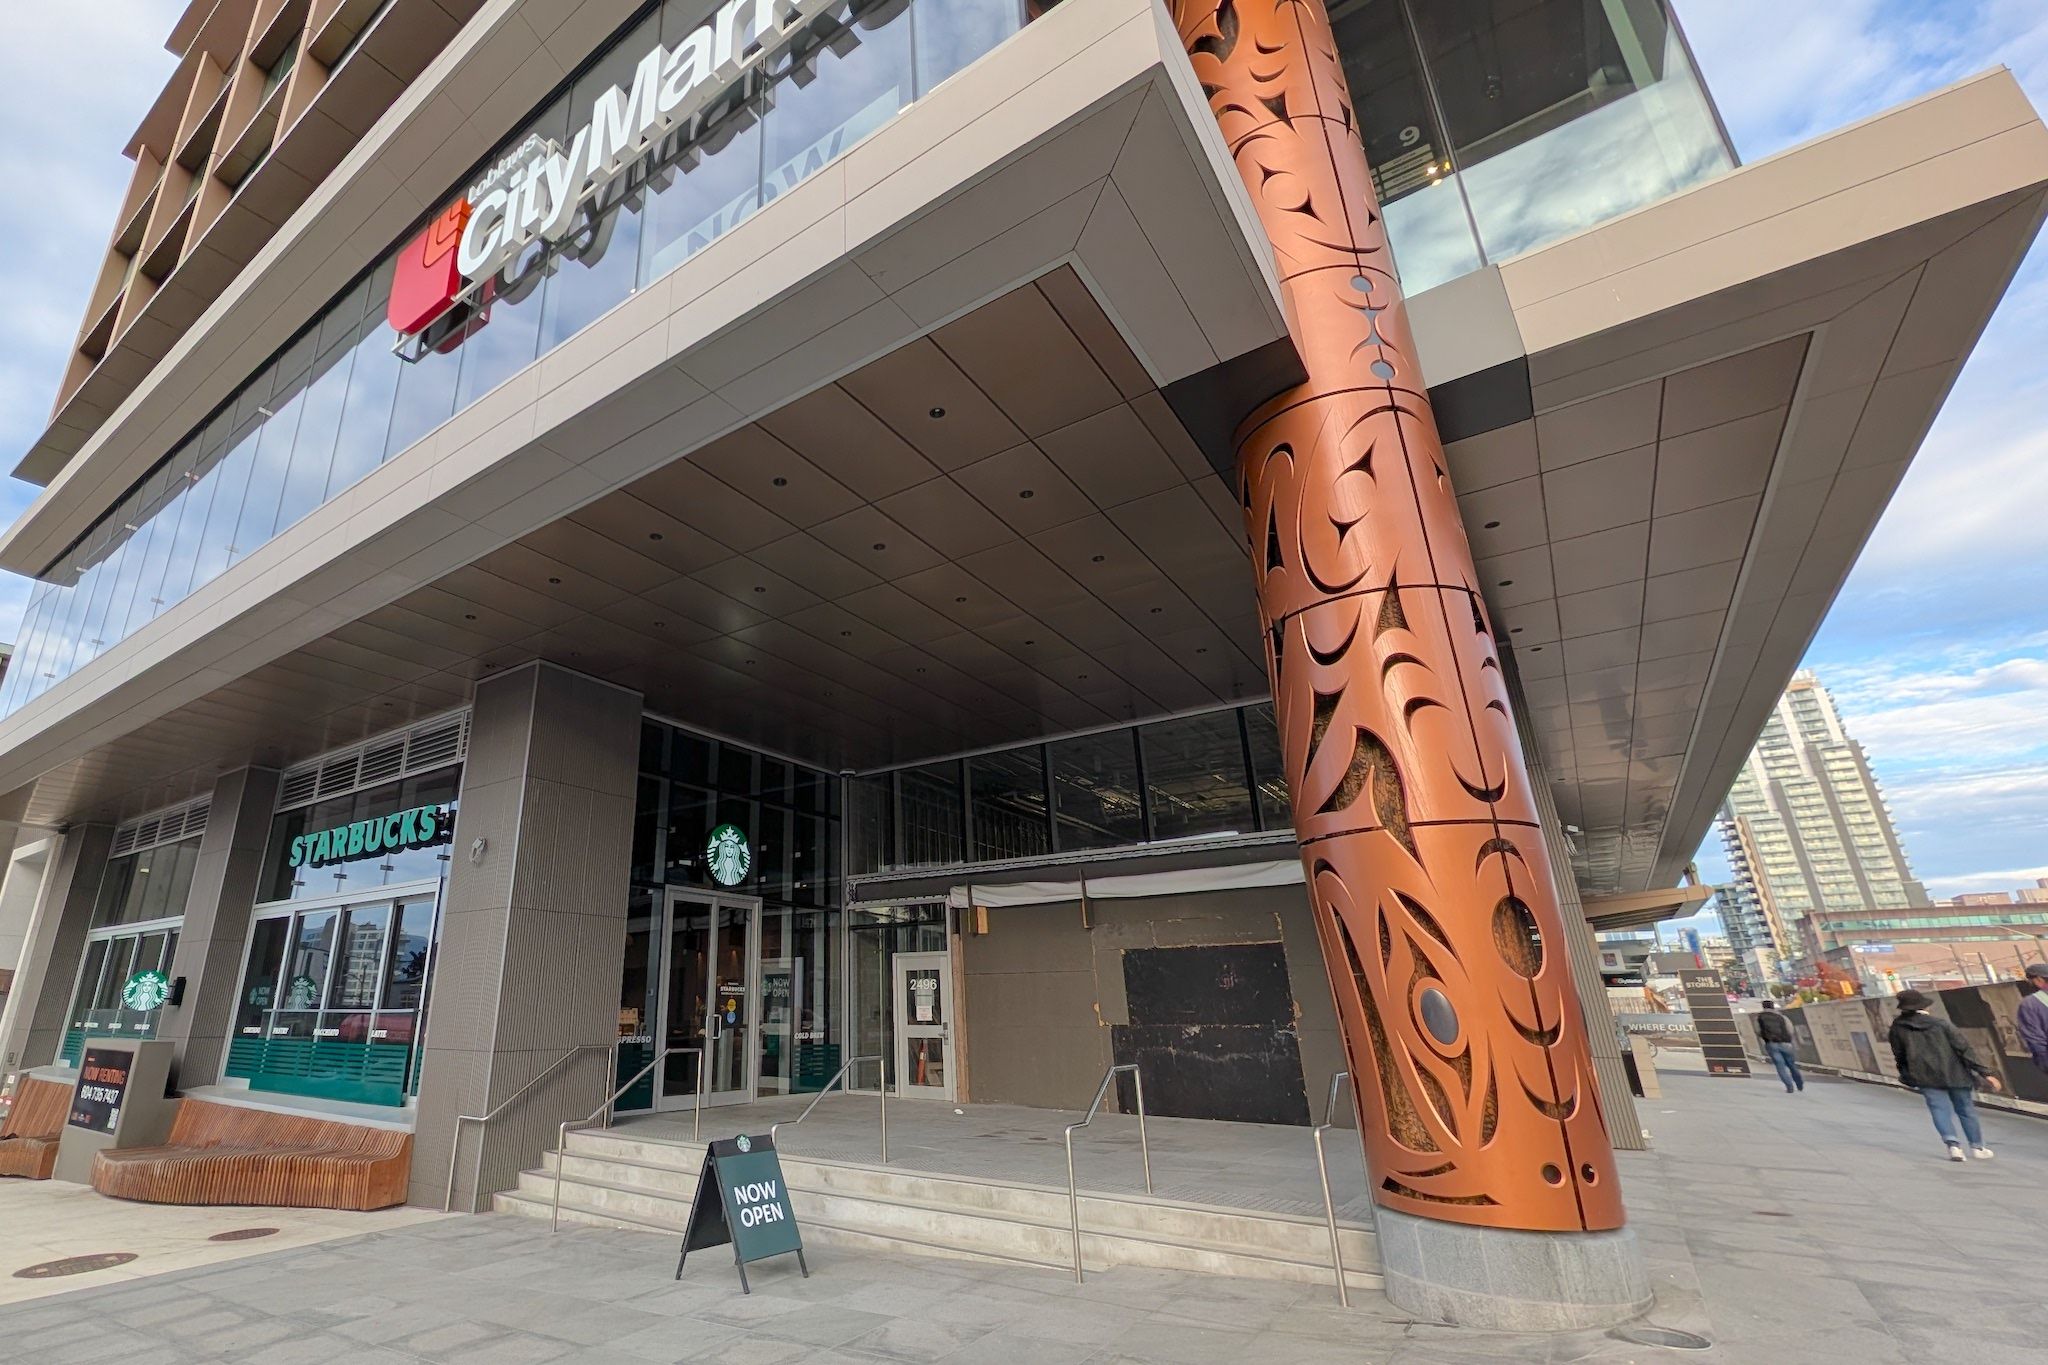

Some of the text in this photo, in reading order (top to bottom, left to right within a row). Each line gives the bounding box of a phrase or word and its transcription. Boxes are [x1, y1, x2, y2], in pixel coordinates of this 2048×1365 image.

[1399, 126, 1420, 147] 9
[467, 133, 540, 205] Loblaws
[288, 804, 437, 868] STARBUCKS
[772, 988, 790, 998] OPEN
[773, 978, 790, 988] NOW
[909, 978, 938, 991] 2496
[1628, 1023, 1666, 1031] WHERE
[733, 1179, 776, 1206] NOW
[740, 1201, 785, 1228] OPEN
